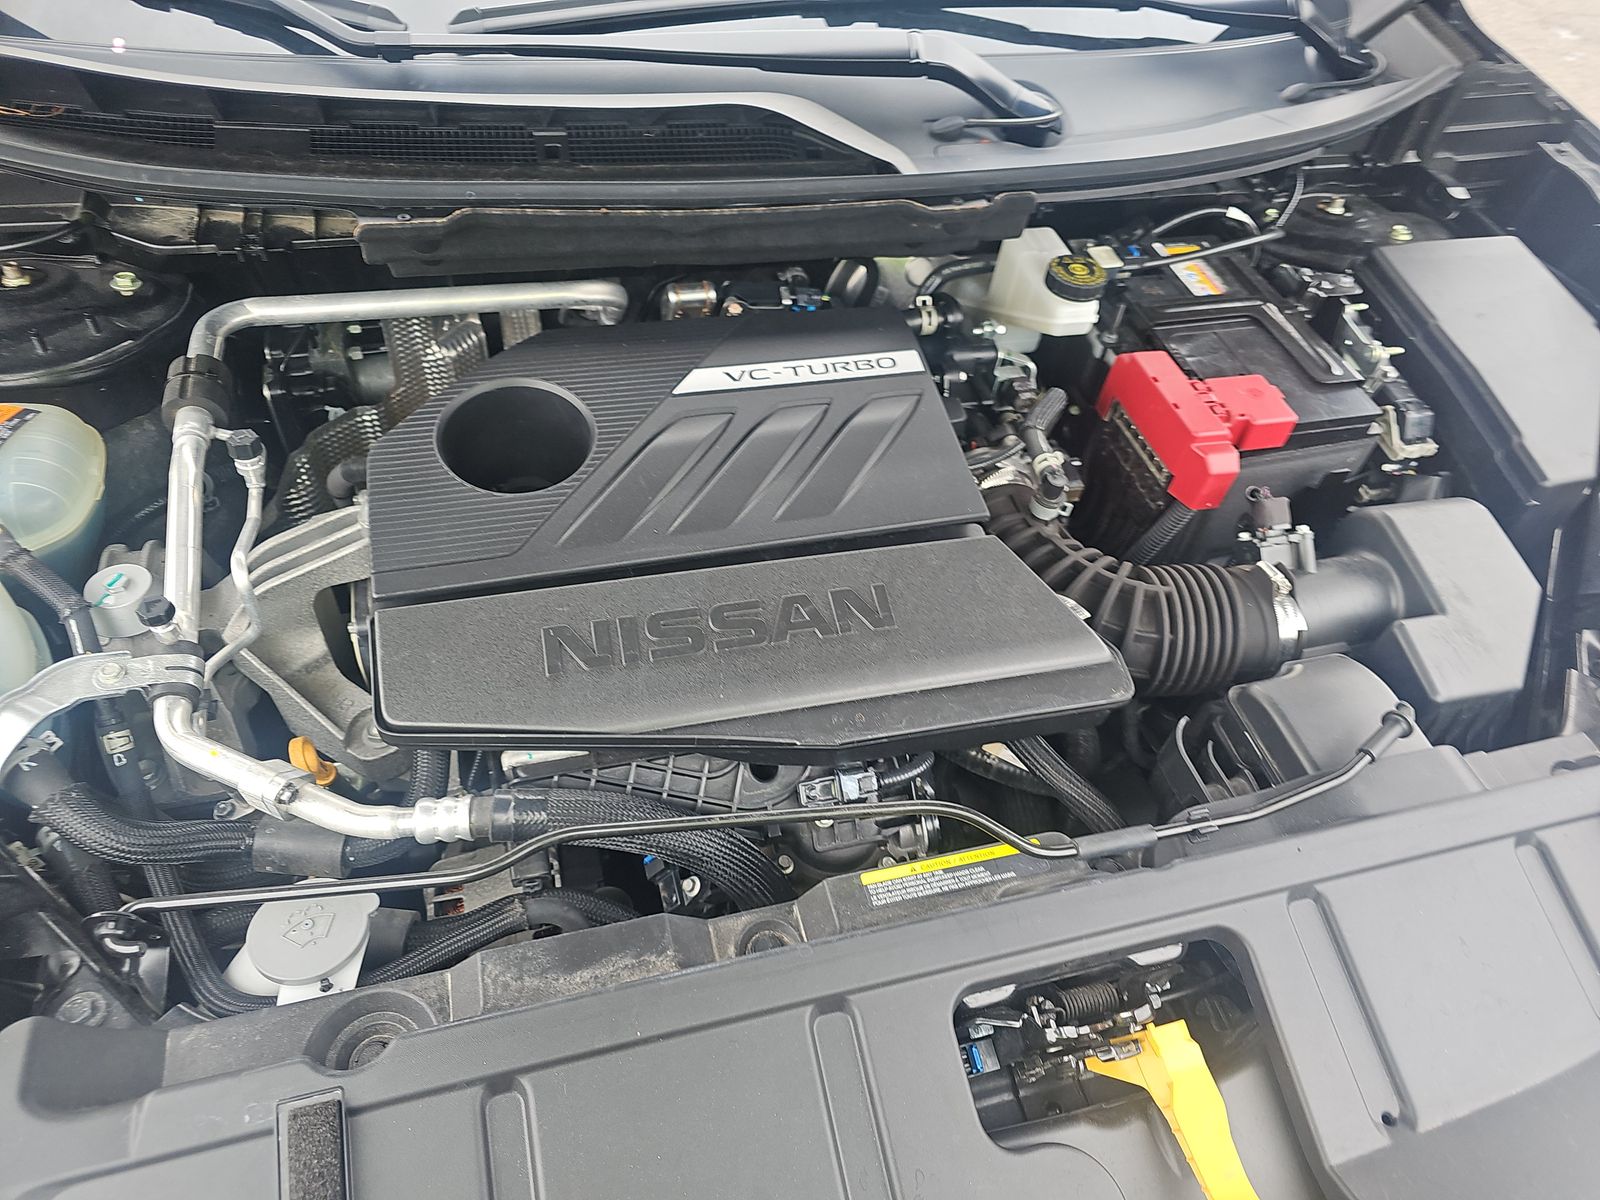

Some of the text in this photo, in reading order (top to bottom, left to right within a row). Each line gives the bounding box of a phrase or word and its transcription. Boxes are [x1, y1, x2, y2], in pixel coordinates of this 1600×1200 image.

[723, 357, 897, 382] VC-TURBO
[540, 583, 898, 678] NISSAN
[920, 859, 952, 870] CAUTION
[958, 850, 996, 862] ATTENTION
